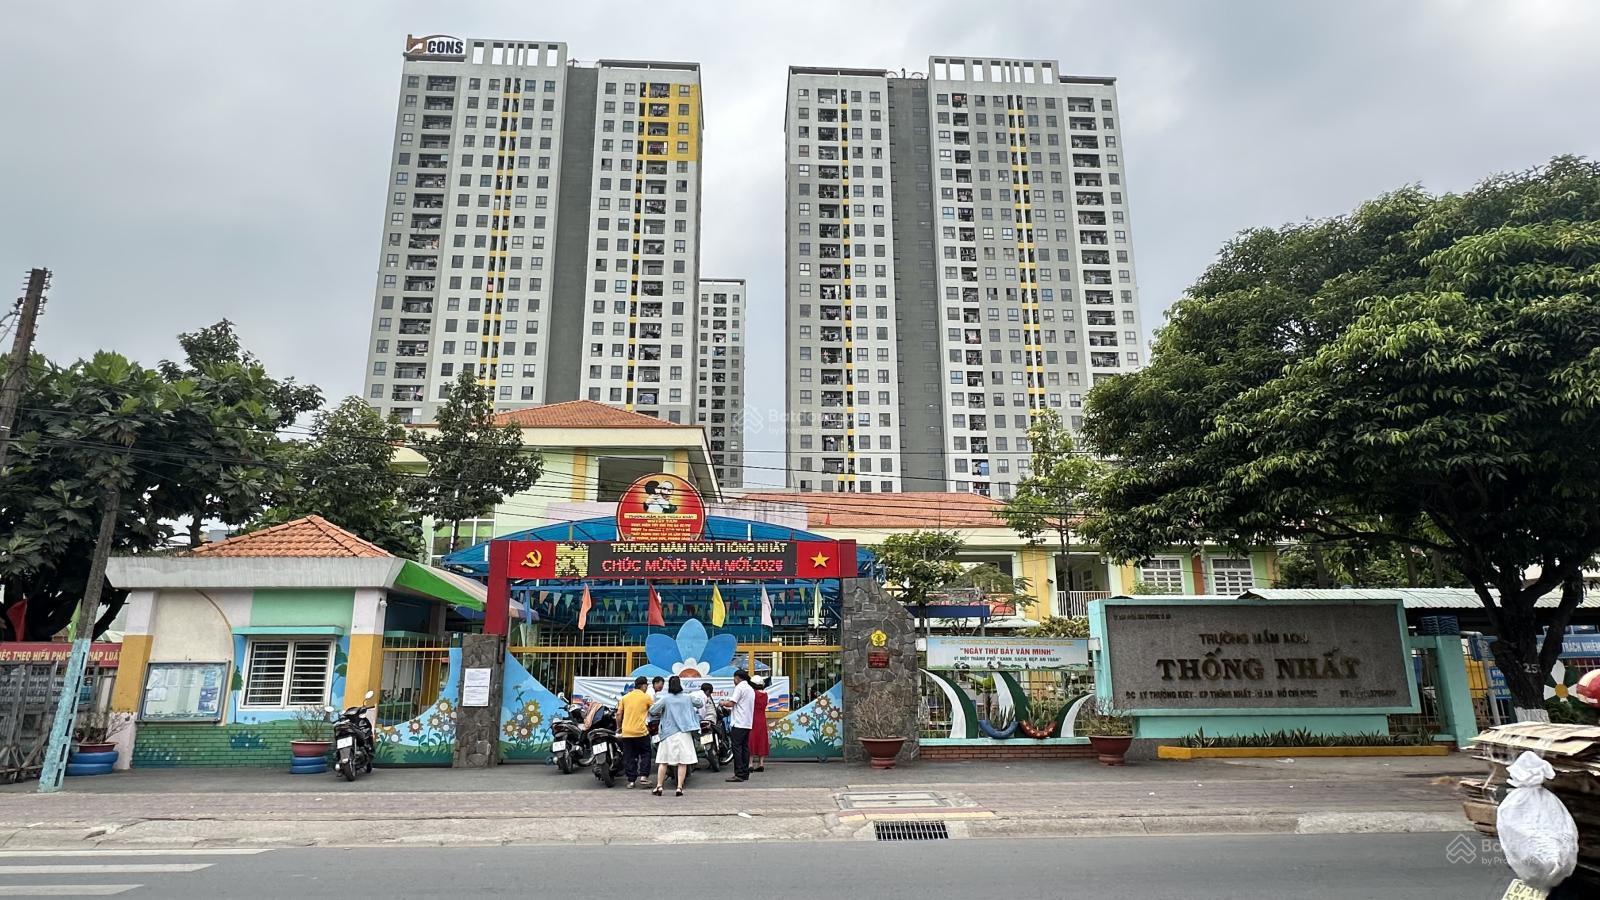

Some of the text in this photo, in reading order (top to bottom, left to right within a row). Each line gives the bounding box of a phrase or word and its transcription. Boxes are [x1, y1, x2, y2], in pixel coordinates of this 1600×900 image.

[689, 542, 714, 553] NON
[690, 557, 721, 572] NĂM
[12, 651, 31, 662] THEO
[1156, 646, 1362, 682] THỐNG NHẤT
